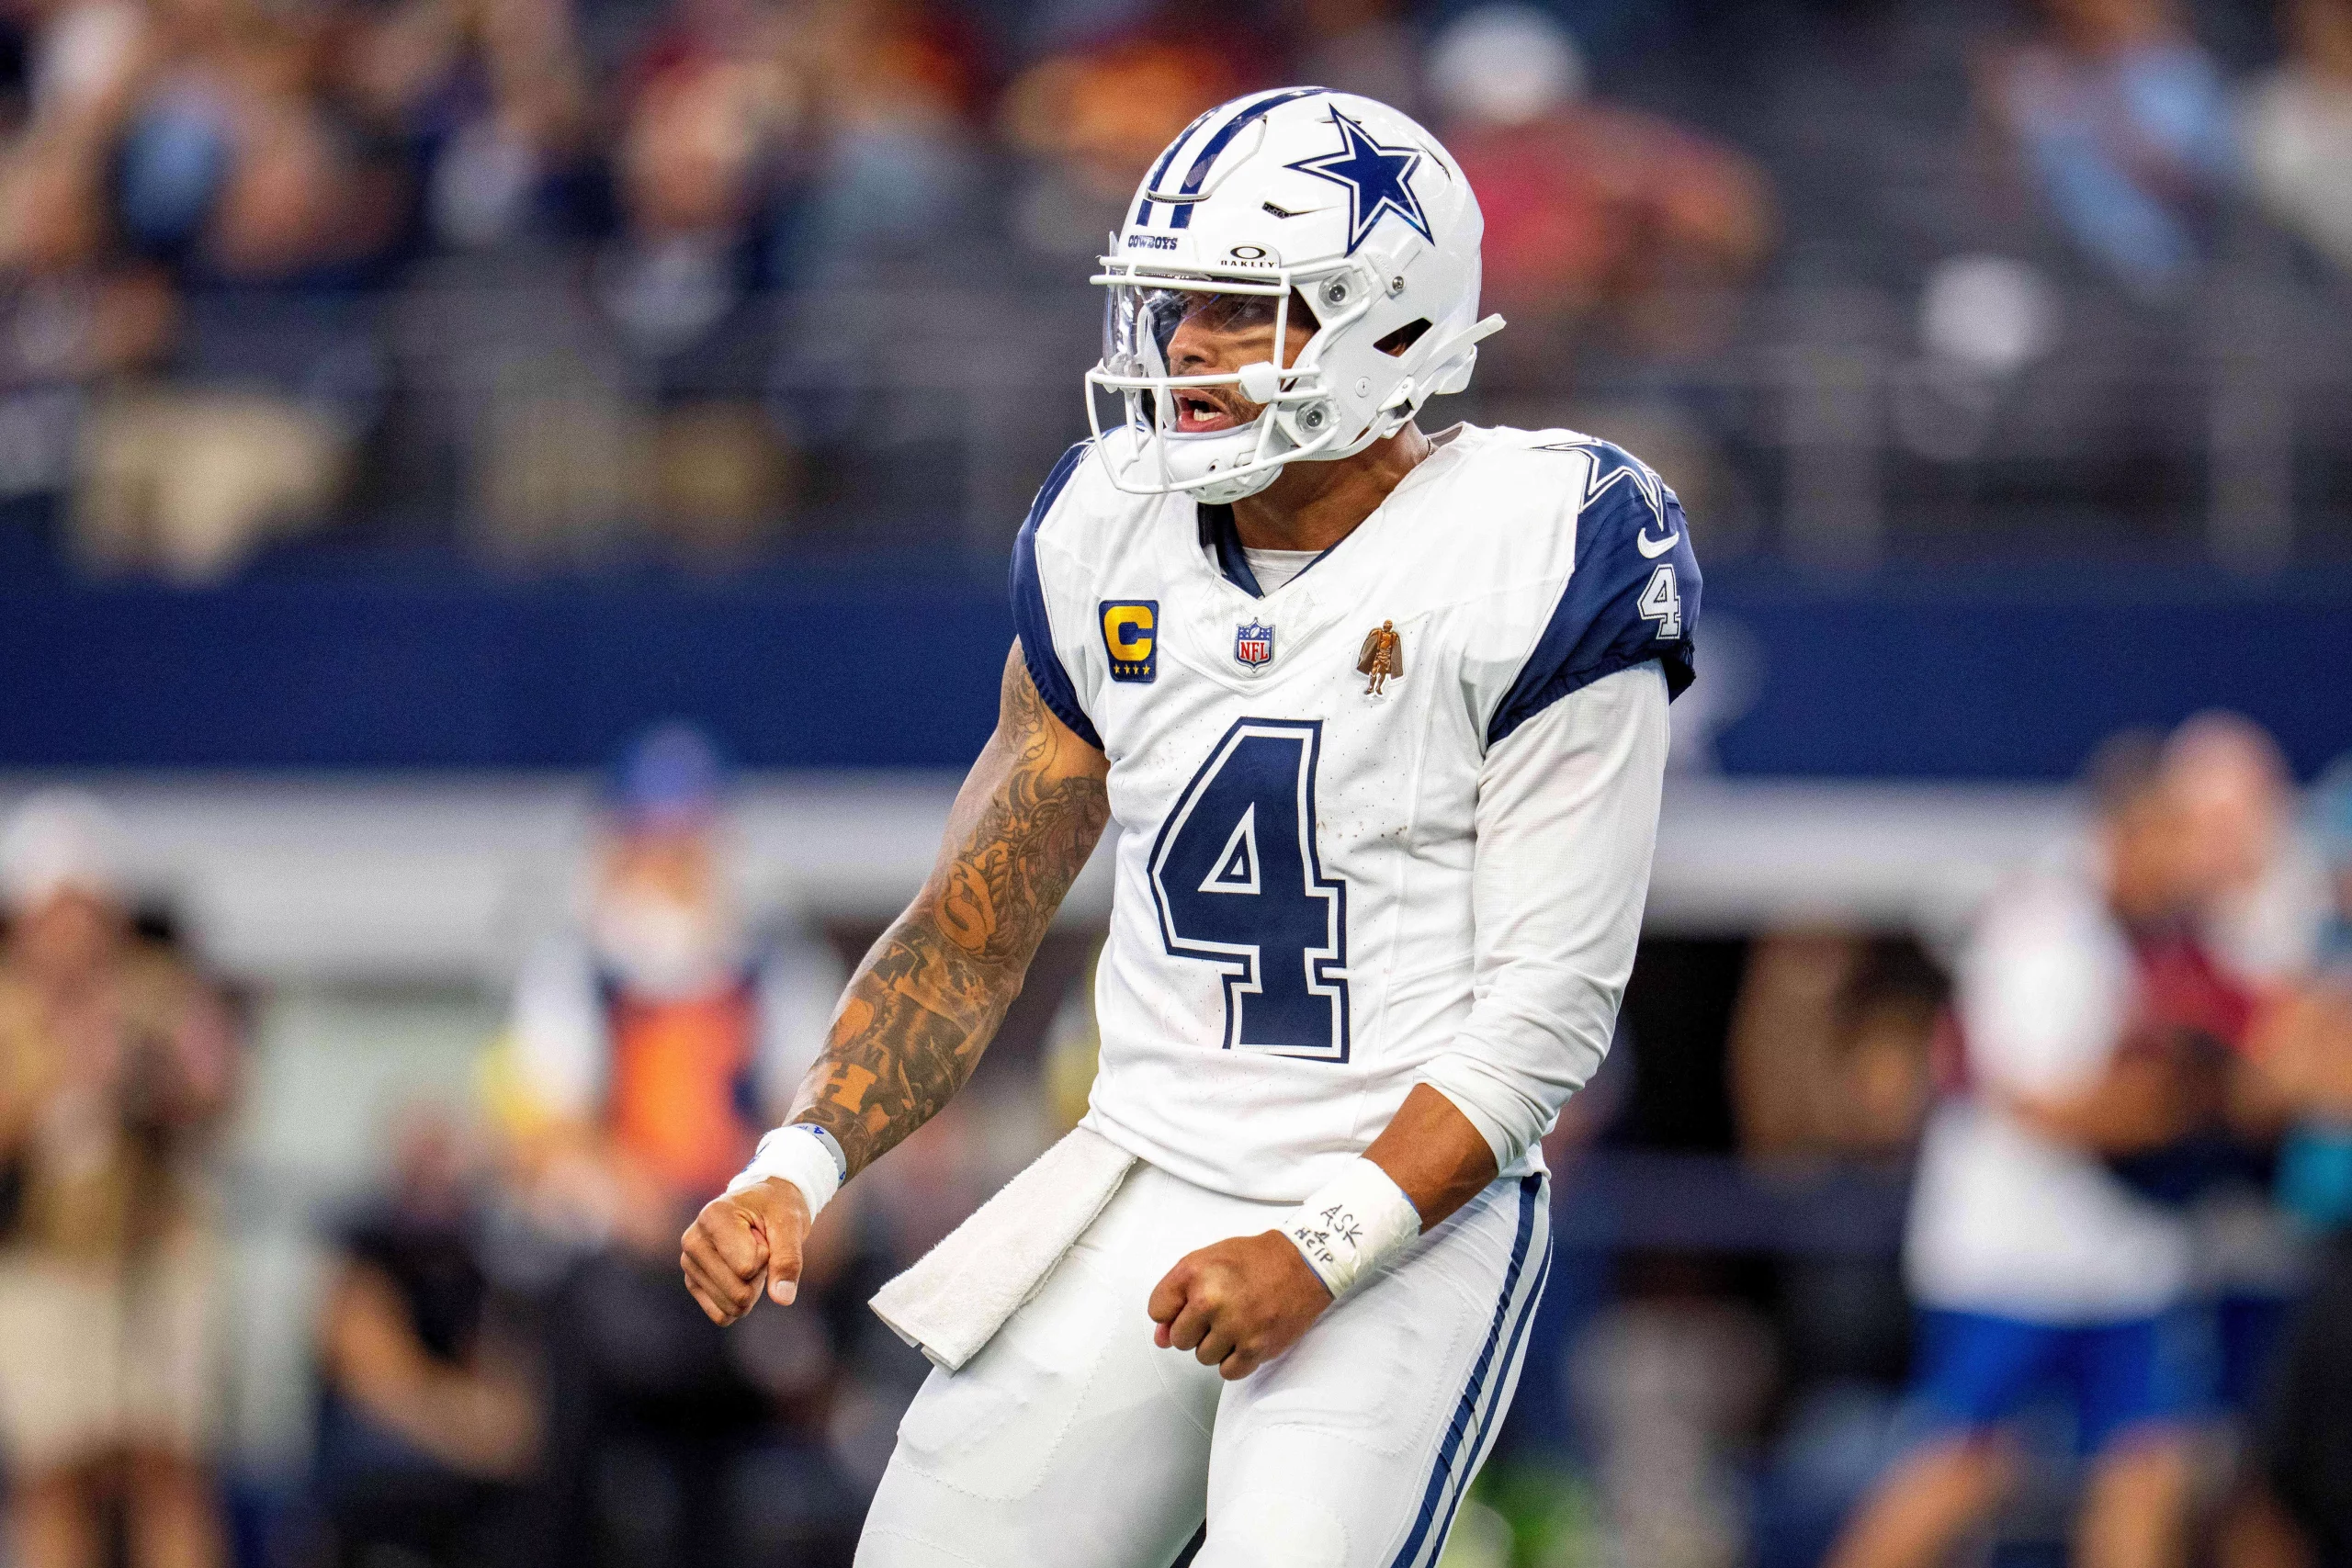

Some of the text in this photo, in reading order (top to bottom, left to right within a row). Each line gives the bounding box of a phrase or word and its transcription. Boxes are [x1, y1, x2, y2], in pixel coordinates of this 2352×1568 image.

[1128, 234, 1178, 250] COWBOYS
[1220, 259, 1274, 268] OAKLEY
[1637, 564, 1680, 640] 4
[1103, 605, 1153, 661] C
[1239, 640, 1269, 662] NFL
[1147, 716, 1350, 1063] 4
[1320, 1204, 1363, 1249] ASK
